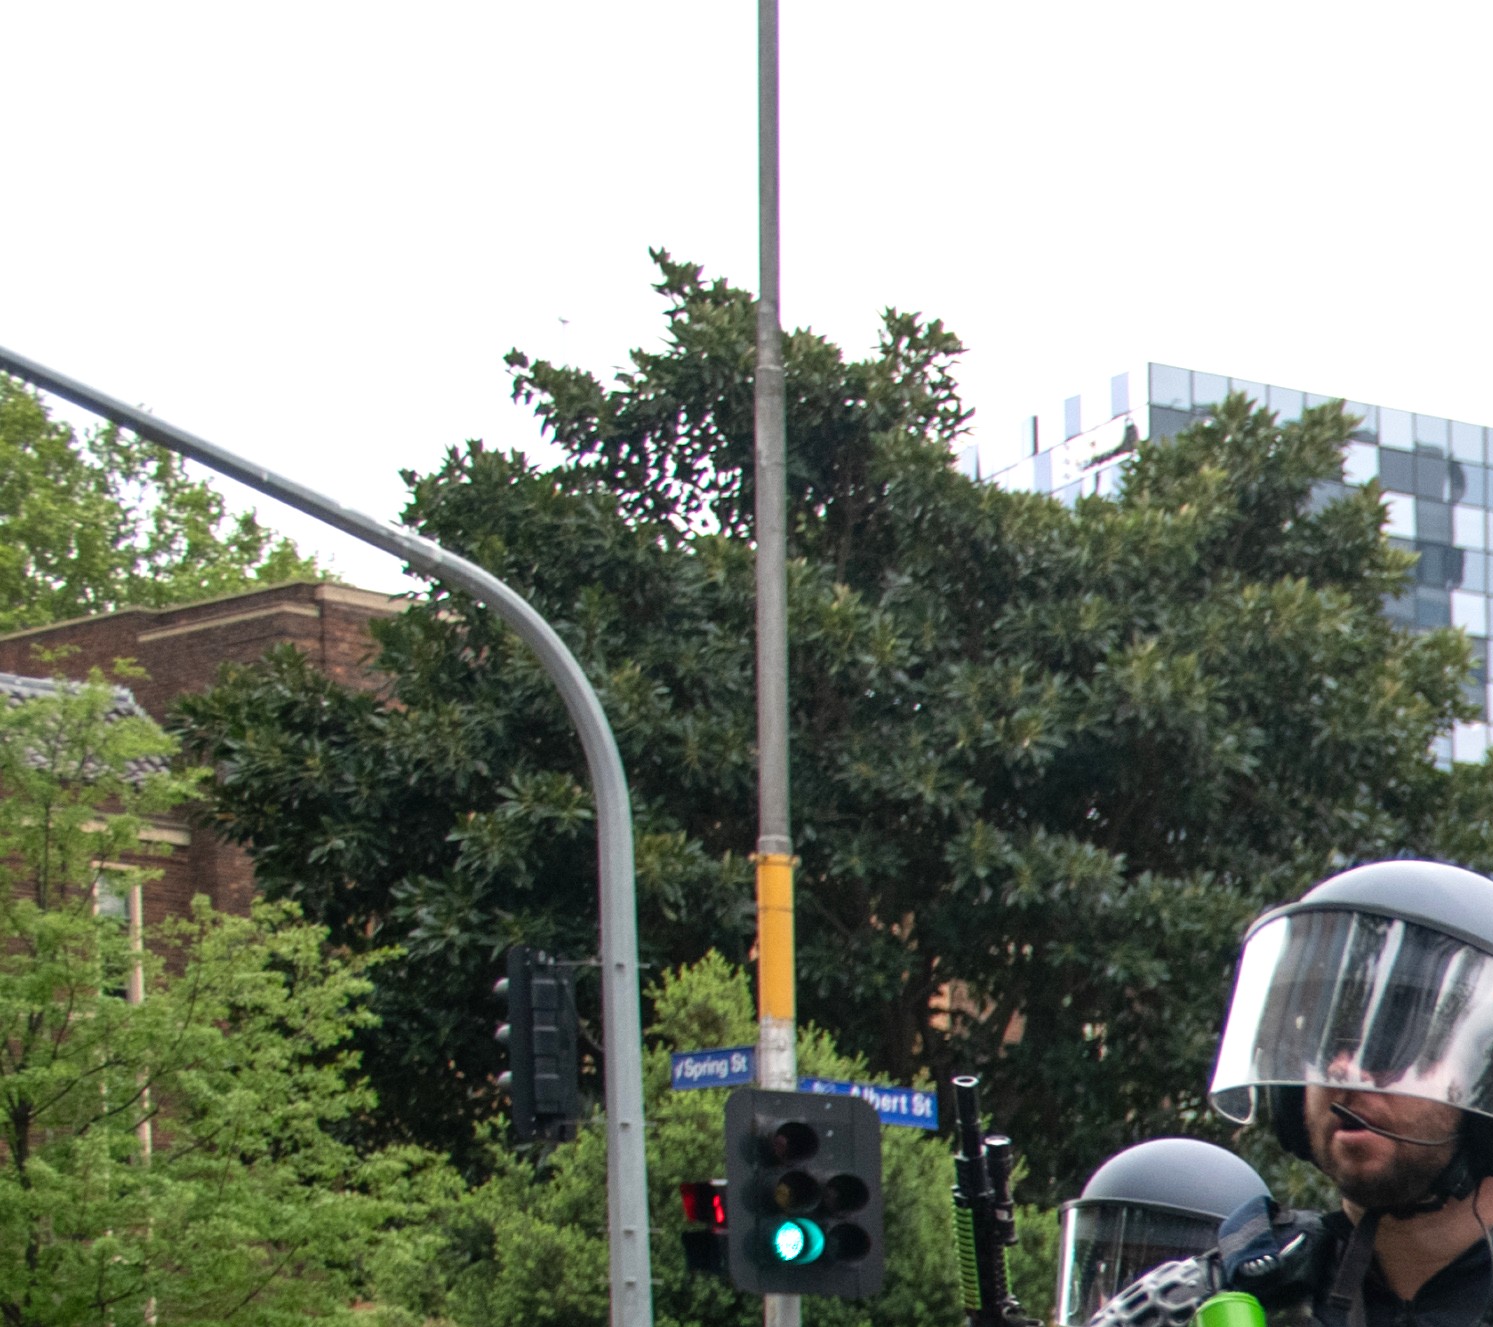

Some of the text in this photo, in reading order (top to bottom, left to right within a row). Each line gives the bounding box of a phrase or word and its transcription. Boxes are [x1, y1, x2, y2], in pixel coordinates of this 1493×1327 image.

[683, 1053, 748, 1081] Spring St
[850, 1085, 933, 1118] Albert St
